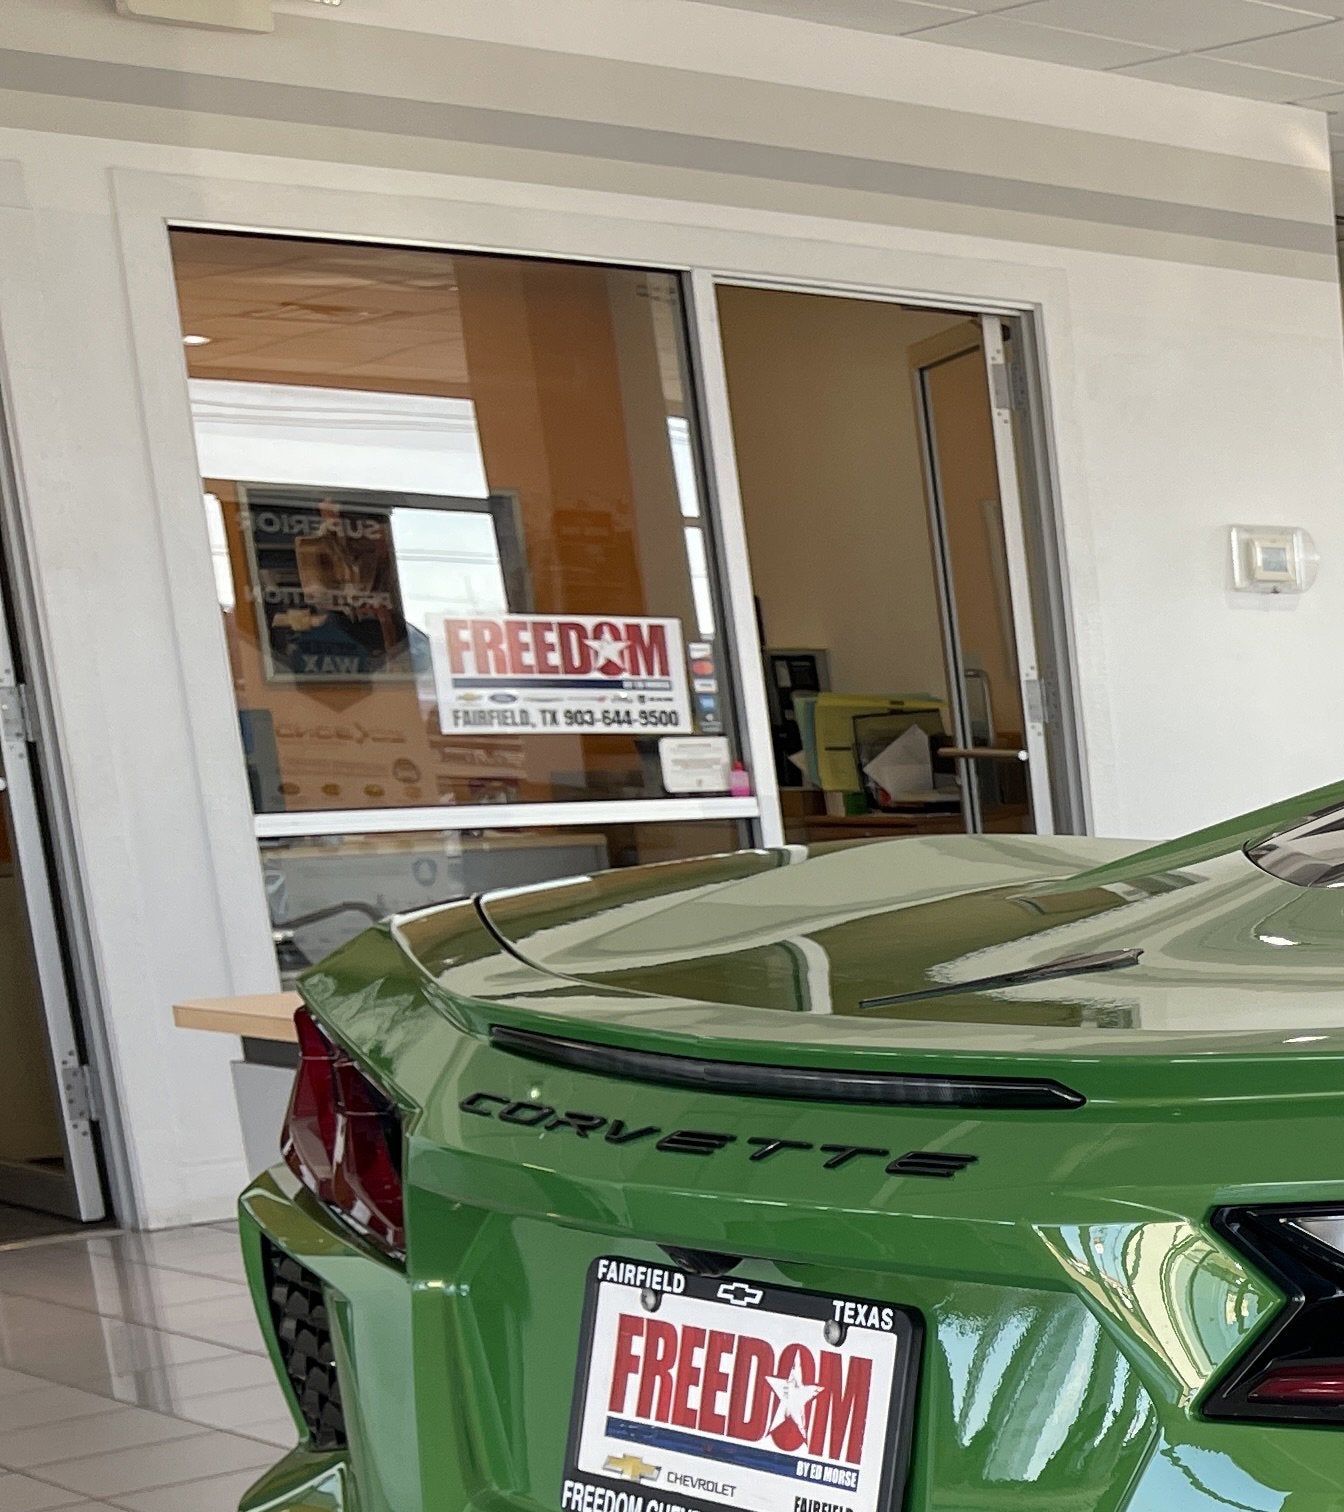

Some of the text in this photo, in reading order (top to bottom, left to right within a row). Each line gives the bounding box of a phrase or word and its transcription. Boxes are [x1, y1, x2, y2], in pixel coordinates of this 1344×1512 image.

[444, 619, 670, 677] FREEDOM
[453, 708, 679, 728] FAIRFIELD, TX 903-644-9500
[459, 1092, 979, 1178] CORVETTE
[598, 1259, 686, 1294] FAIRFIELD
[832, 1300, 894, 1331] TEXAS
[608, 1313, 873, 1465] FREEDOM
[667, 1471, 737, 1498] CHEVROLET
[796, 1460, 858, 1489] BY ED MORSE
